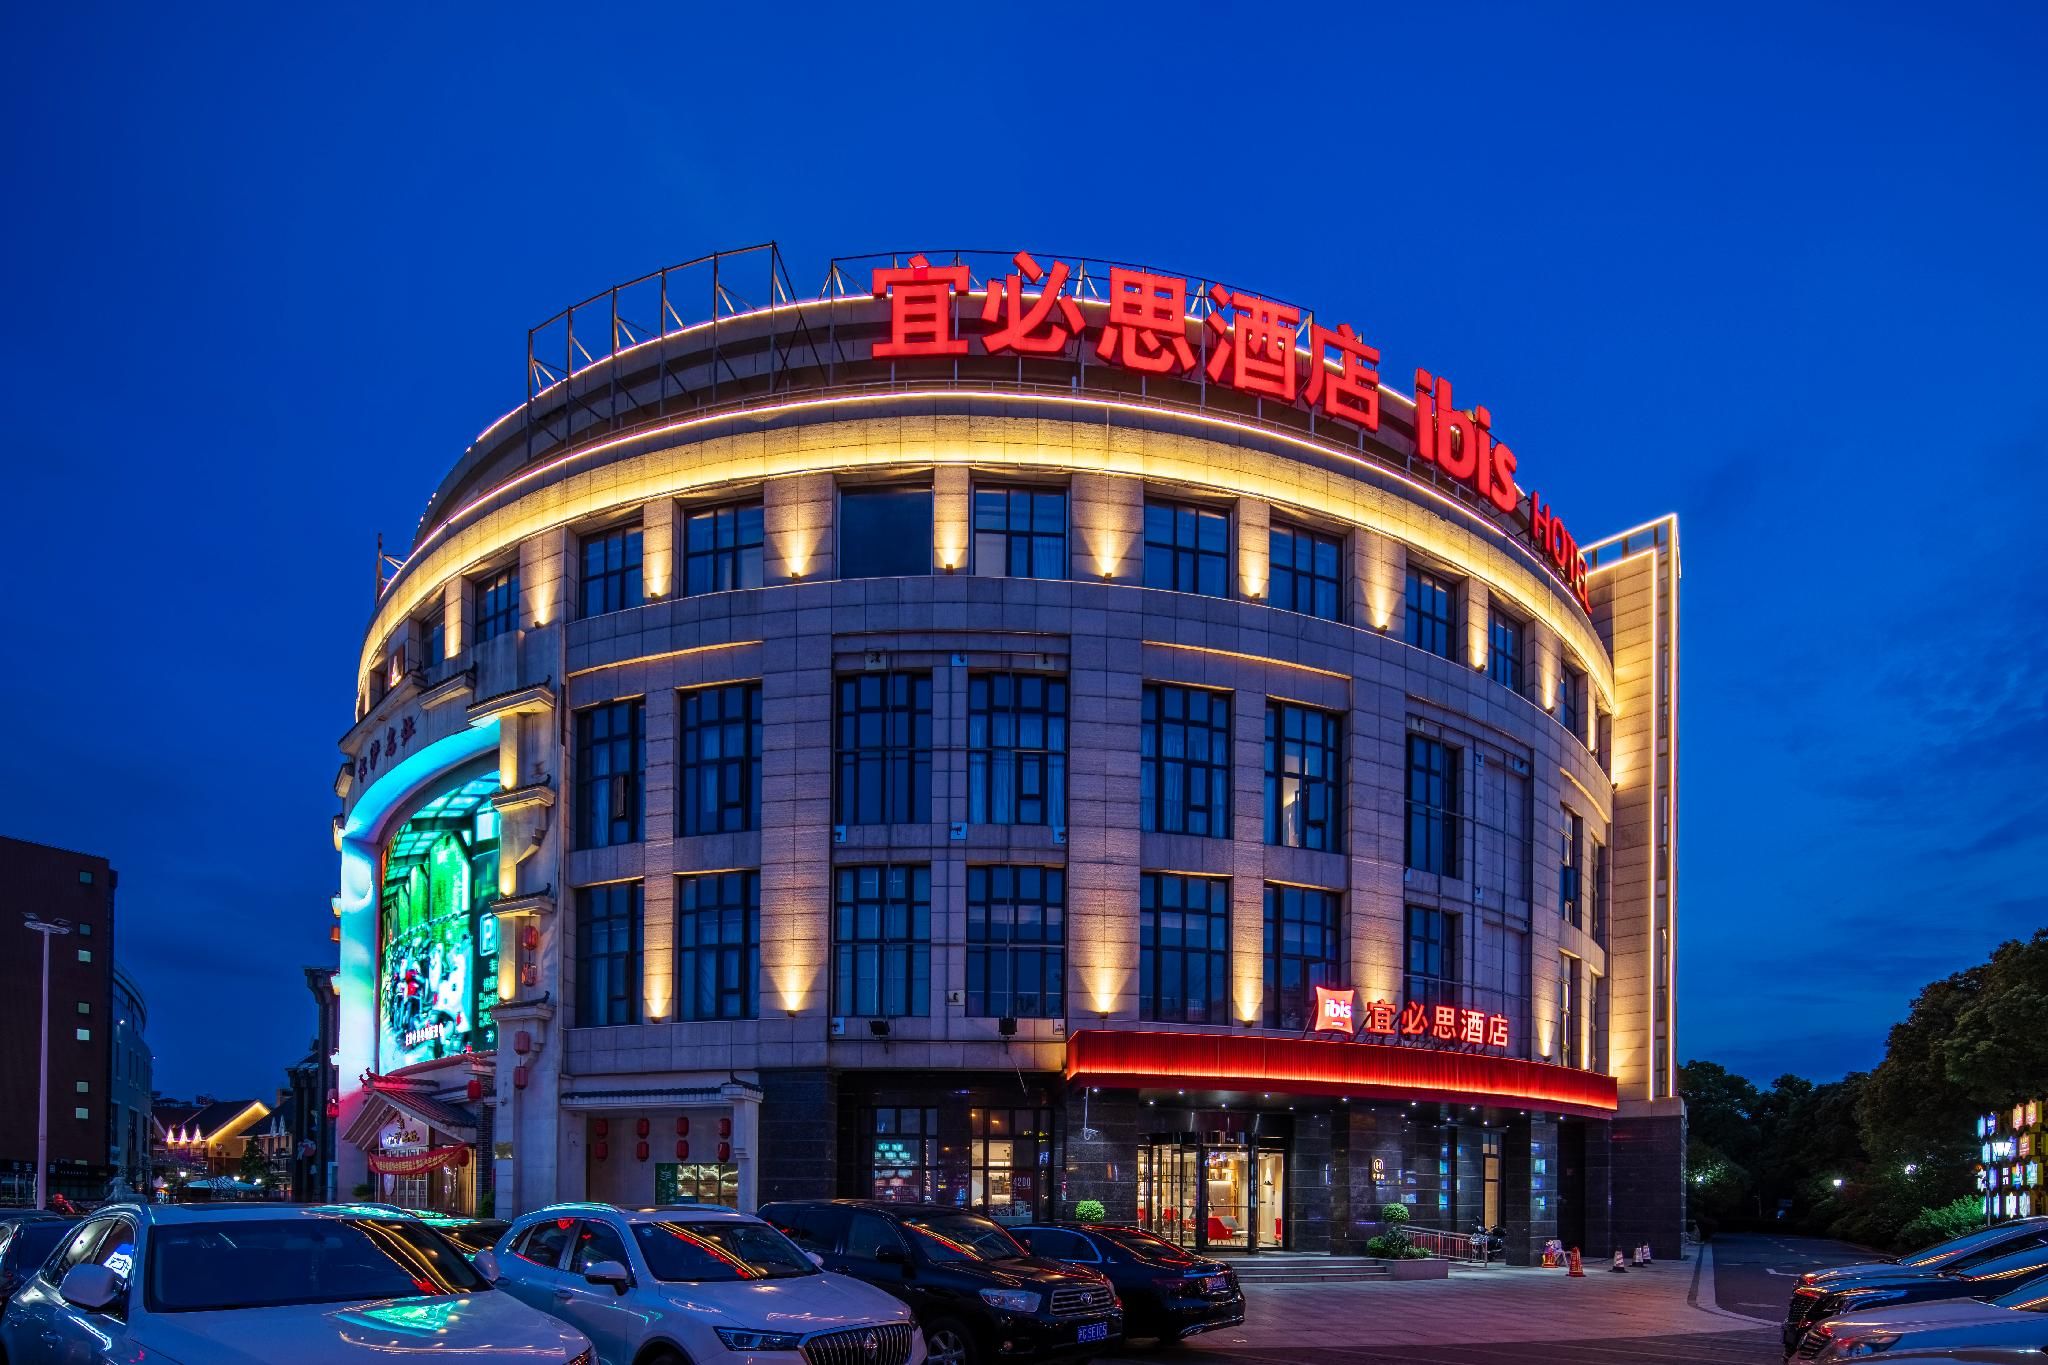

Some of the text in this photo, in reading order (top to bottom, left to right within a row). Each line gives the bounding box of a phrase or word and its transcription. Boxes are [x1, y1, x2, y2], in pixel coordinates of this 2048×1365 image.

[871, 251, 1380, 432] 宜必思酒店
[1415, 368, 1593, 615] ibis HOTEL
[1324, 999, 1353, 1019] ibis
[1366, 998, 1509, 1048] 宜必思酒店
